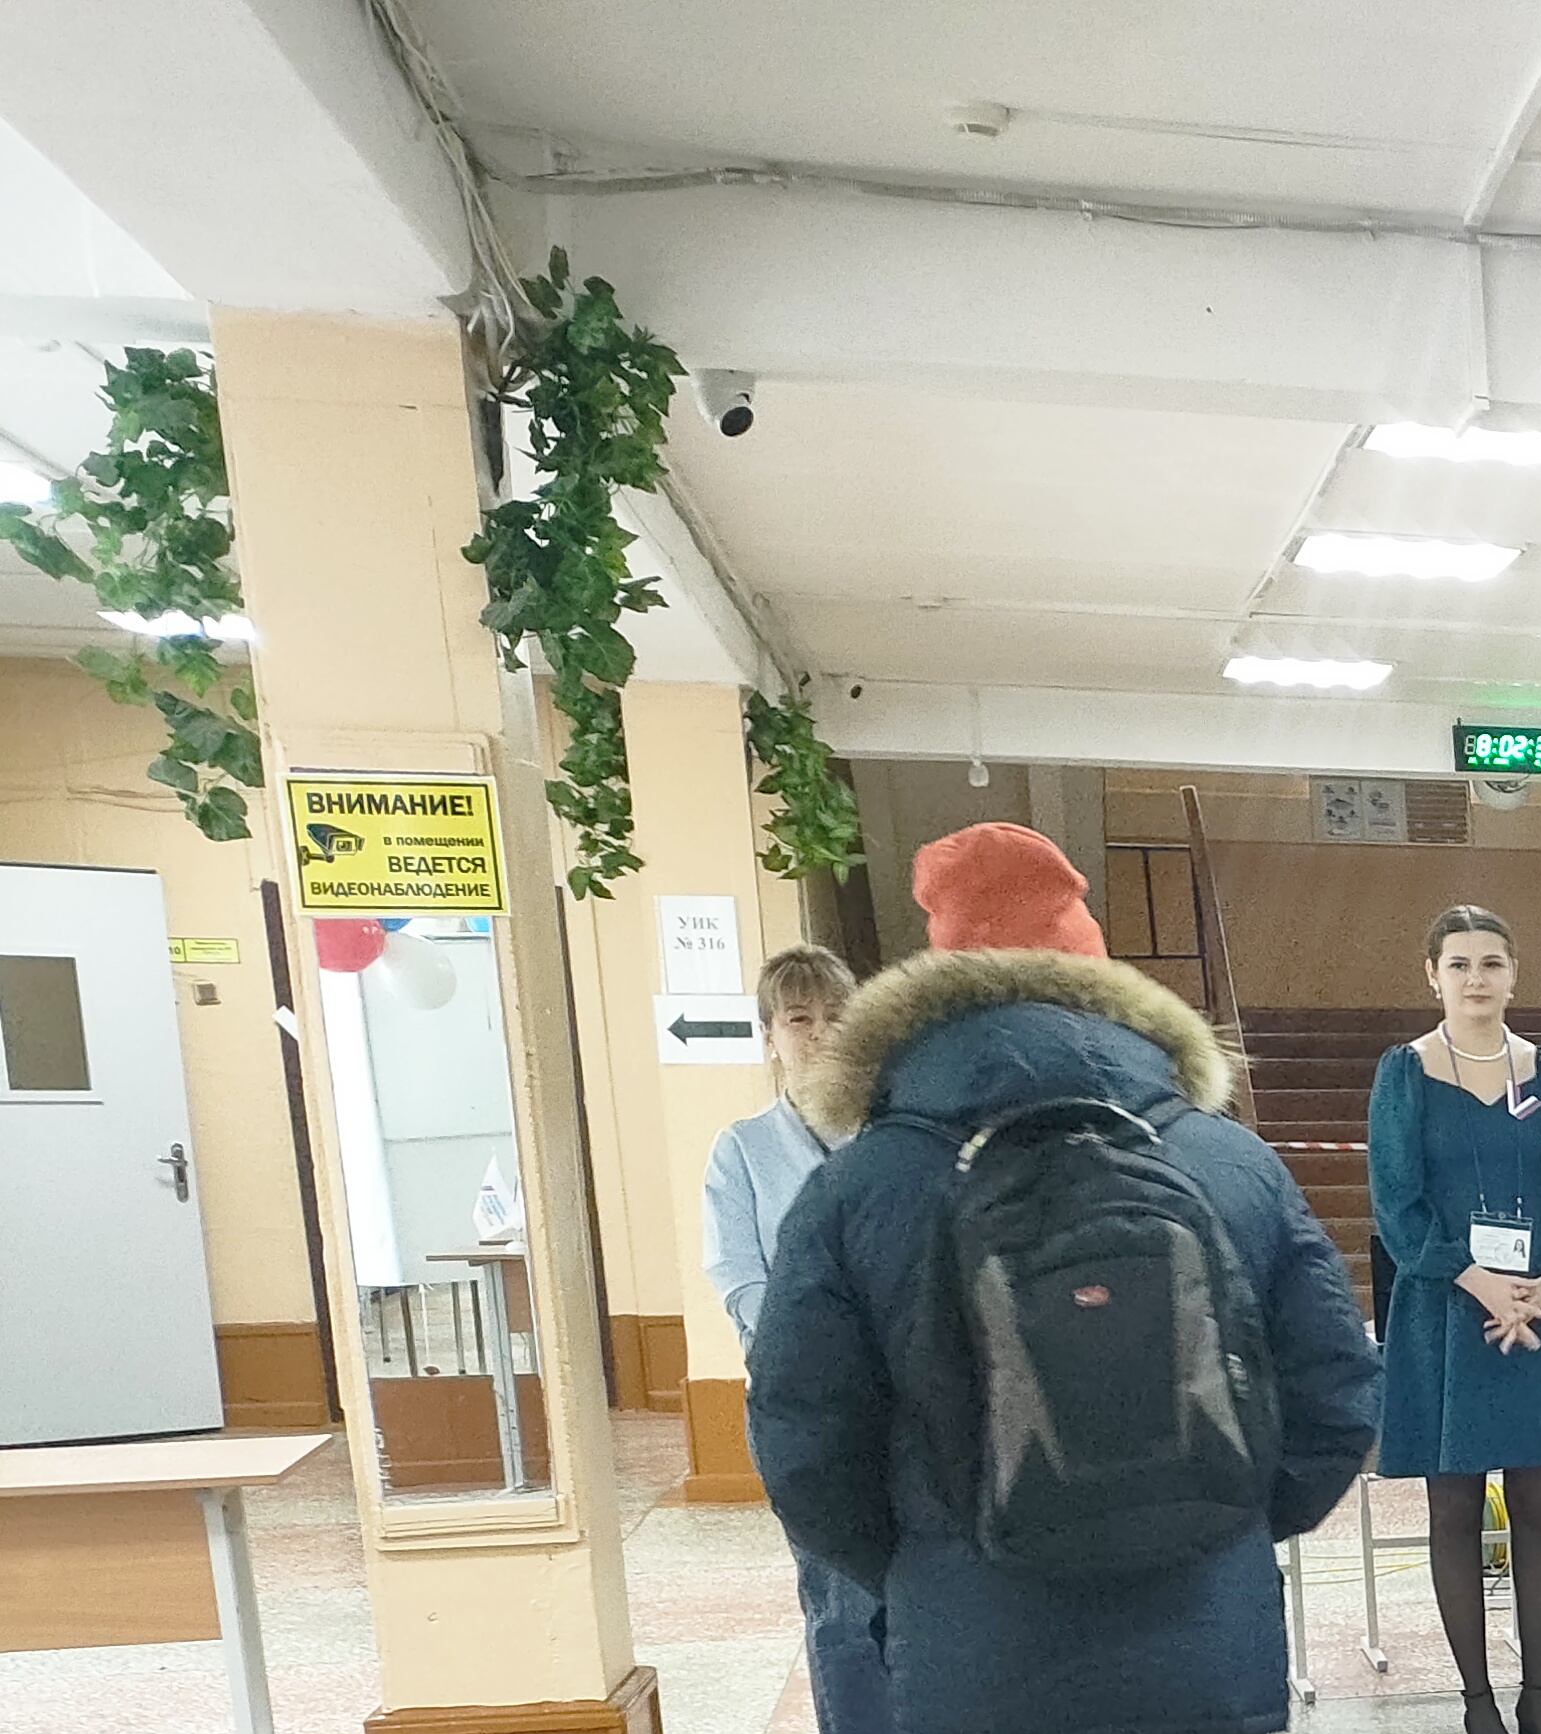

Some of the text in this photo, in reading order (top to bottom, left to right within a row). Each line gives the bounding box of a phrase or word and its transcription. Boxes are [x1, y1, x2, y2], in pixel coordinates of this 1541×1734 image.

[306, 792, 474, 816] ВНИМАНИЕ!
[383, 836, 484, 848] в помещении
[387, 855, 487, 876] ВЕДЕТСЯ
[310, 881, 491, 899] ВИДЕОНАБЛЮДЕНИЕ
[677, 916, 719, 930] УИК
[674, 936, 725, 950] № 316
